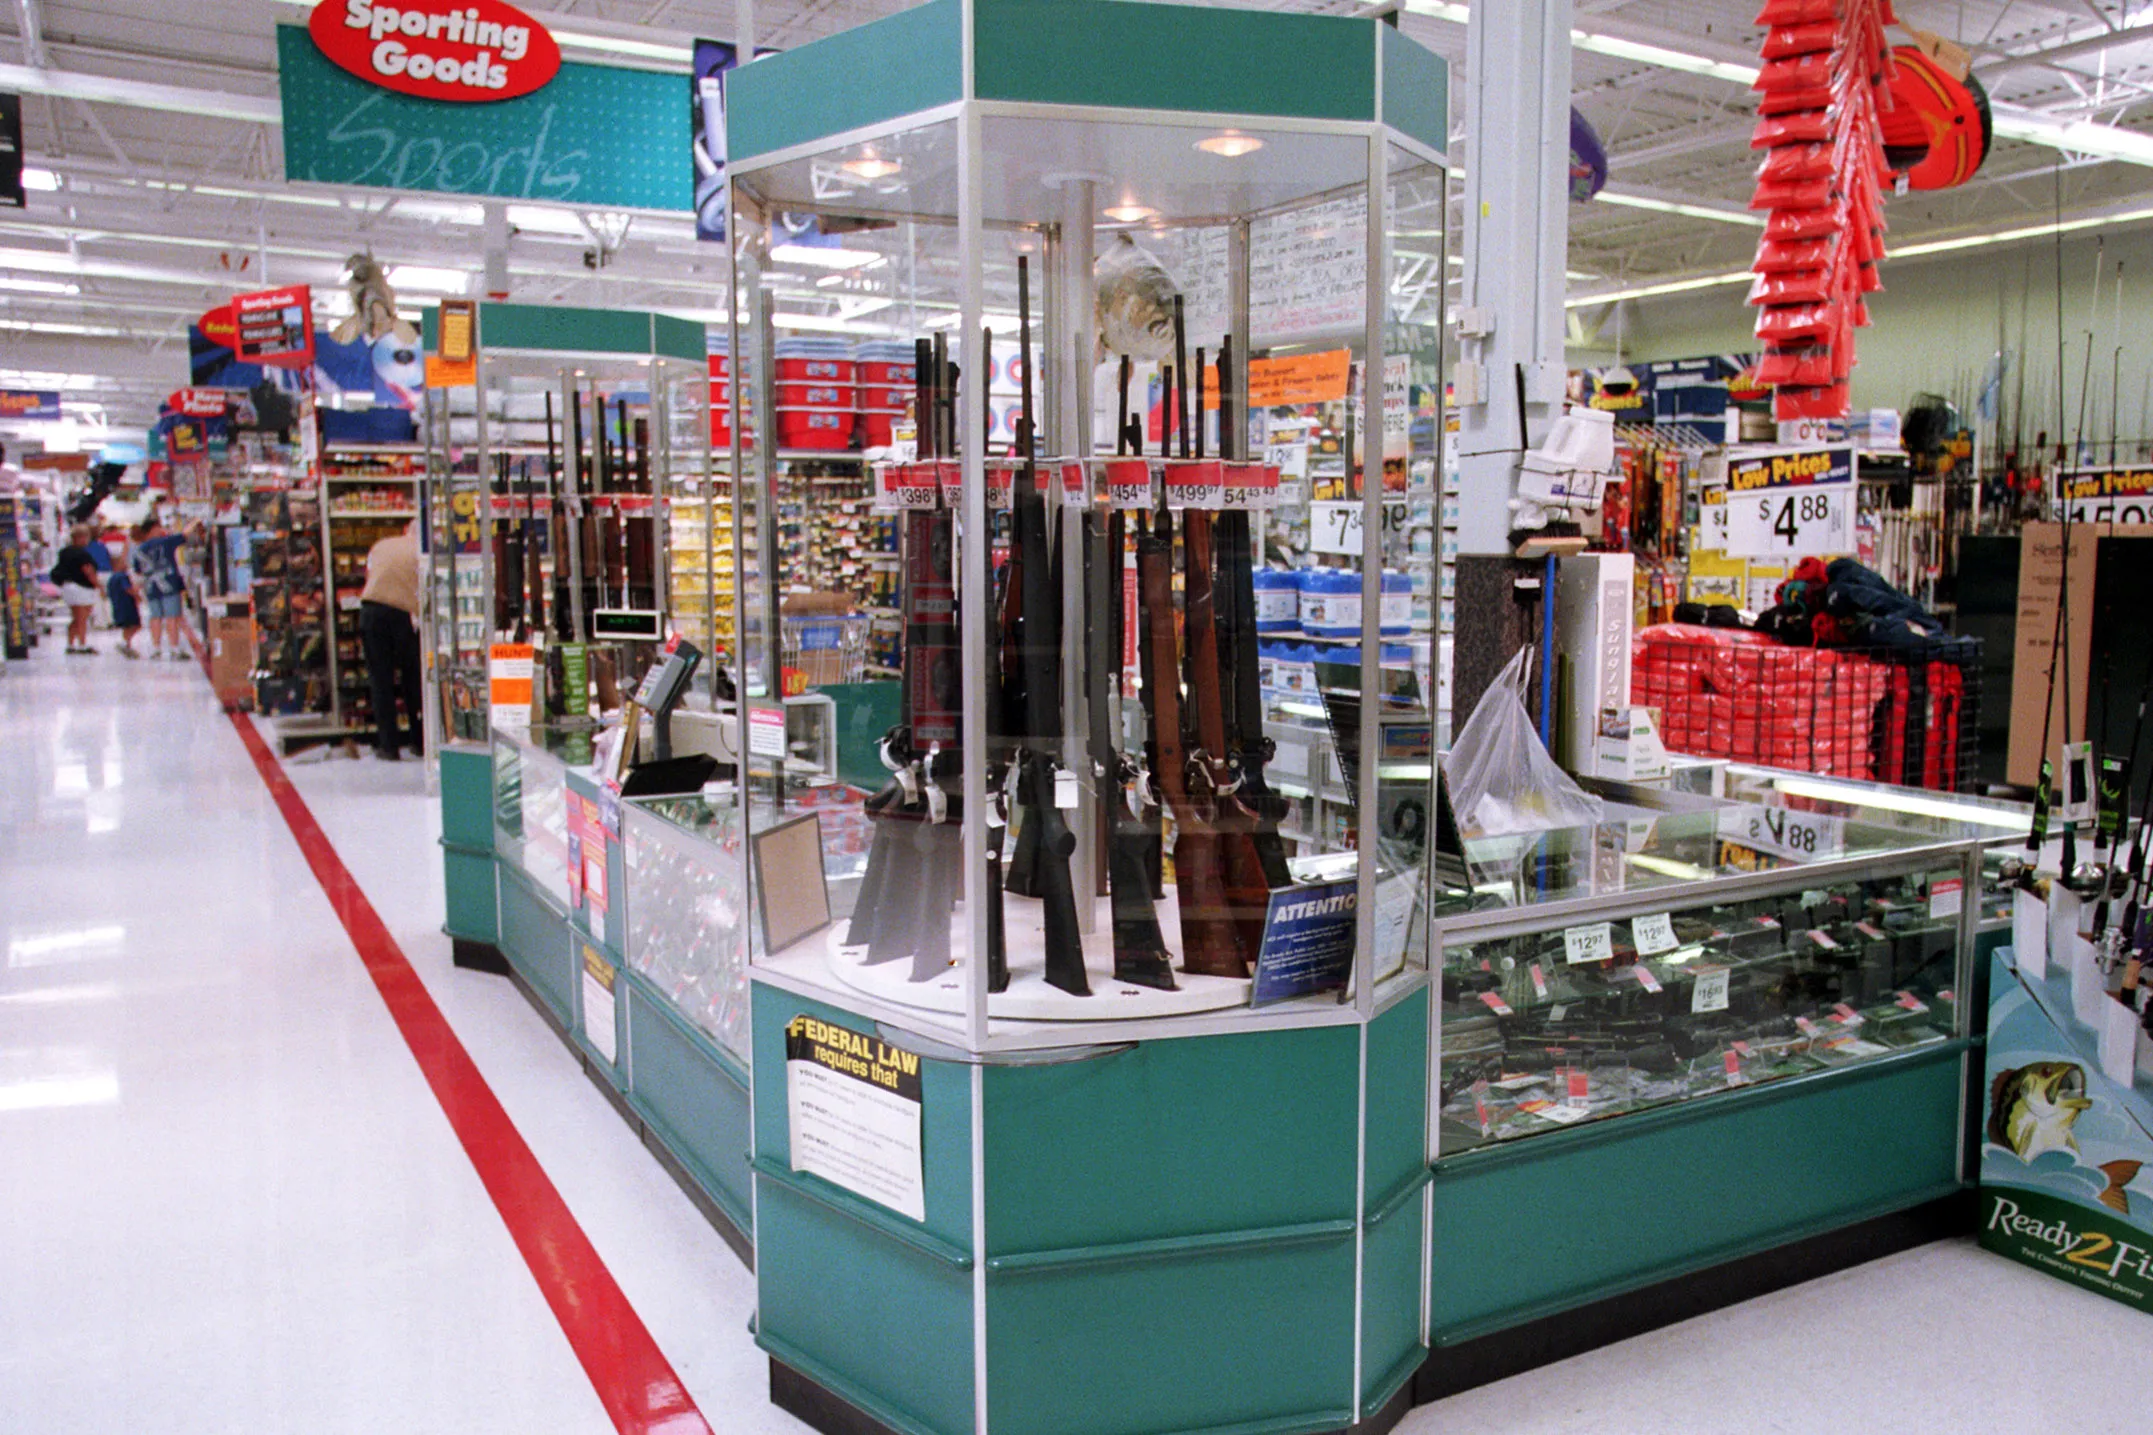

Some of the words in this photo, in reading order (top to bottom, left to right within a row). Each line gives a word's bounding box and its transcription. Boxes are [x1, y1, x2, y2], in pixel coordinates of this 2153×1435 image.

[342, 0, 530, 60] Sporting
[371, 40, 509, 90] Goods
[308, 91, 589, 199] Sports
[1732, 466, 1770, 491] Low
[1772, 452, 1832, 484] Prices
[2103, 469, 2153, 495] Price
[1273, 892, 1357, 925] ATTENTIO
[790, 1017, 874, 1061] FEDERAL
[878, 1042, 919, 1076] LAW
[815, 1045, 868, 1077] requires
[871, 1062, 898, 1089] that
[1987, 1196, 2153, 1281] Ready2Fi
